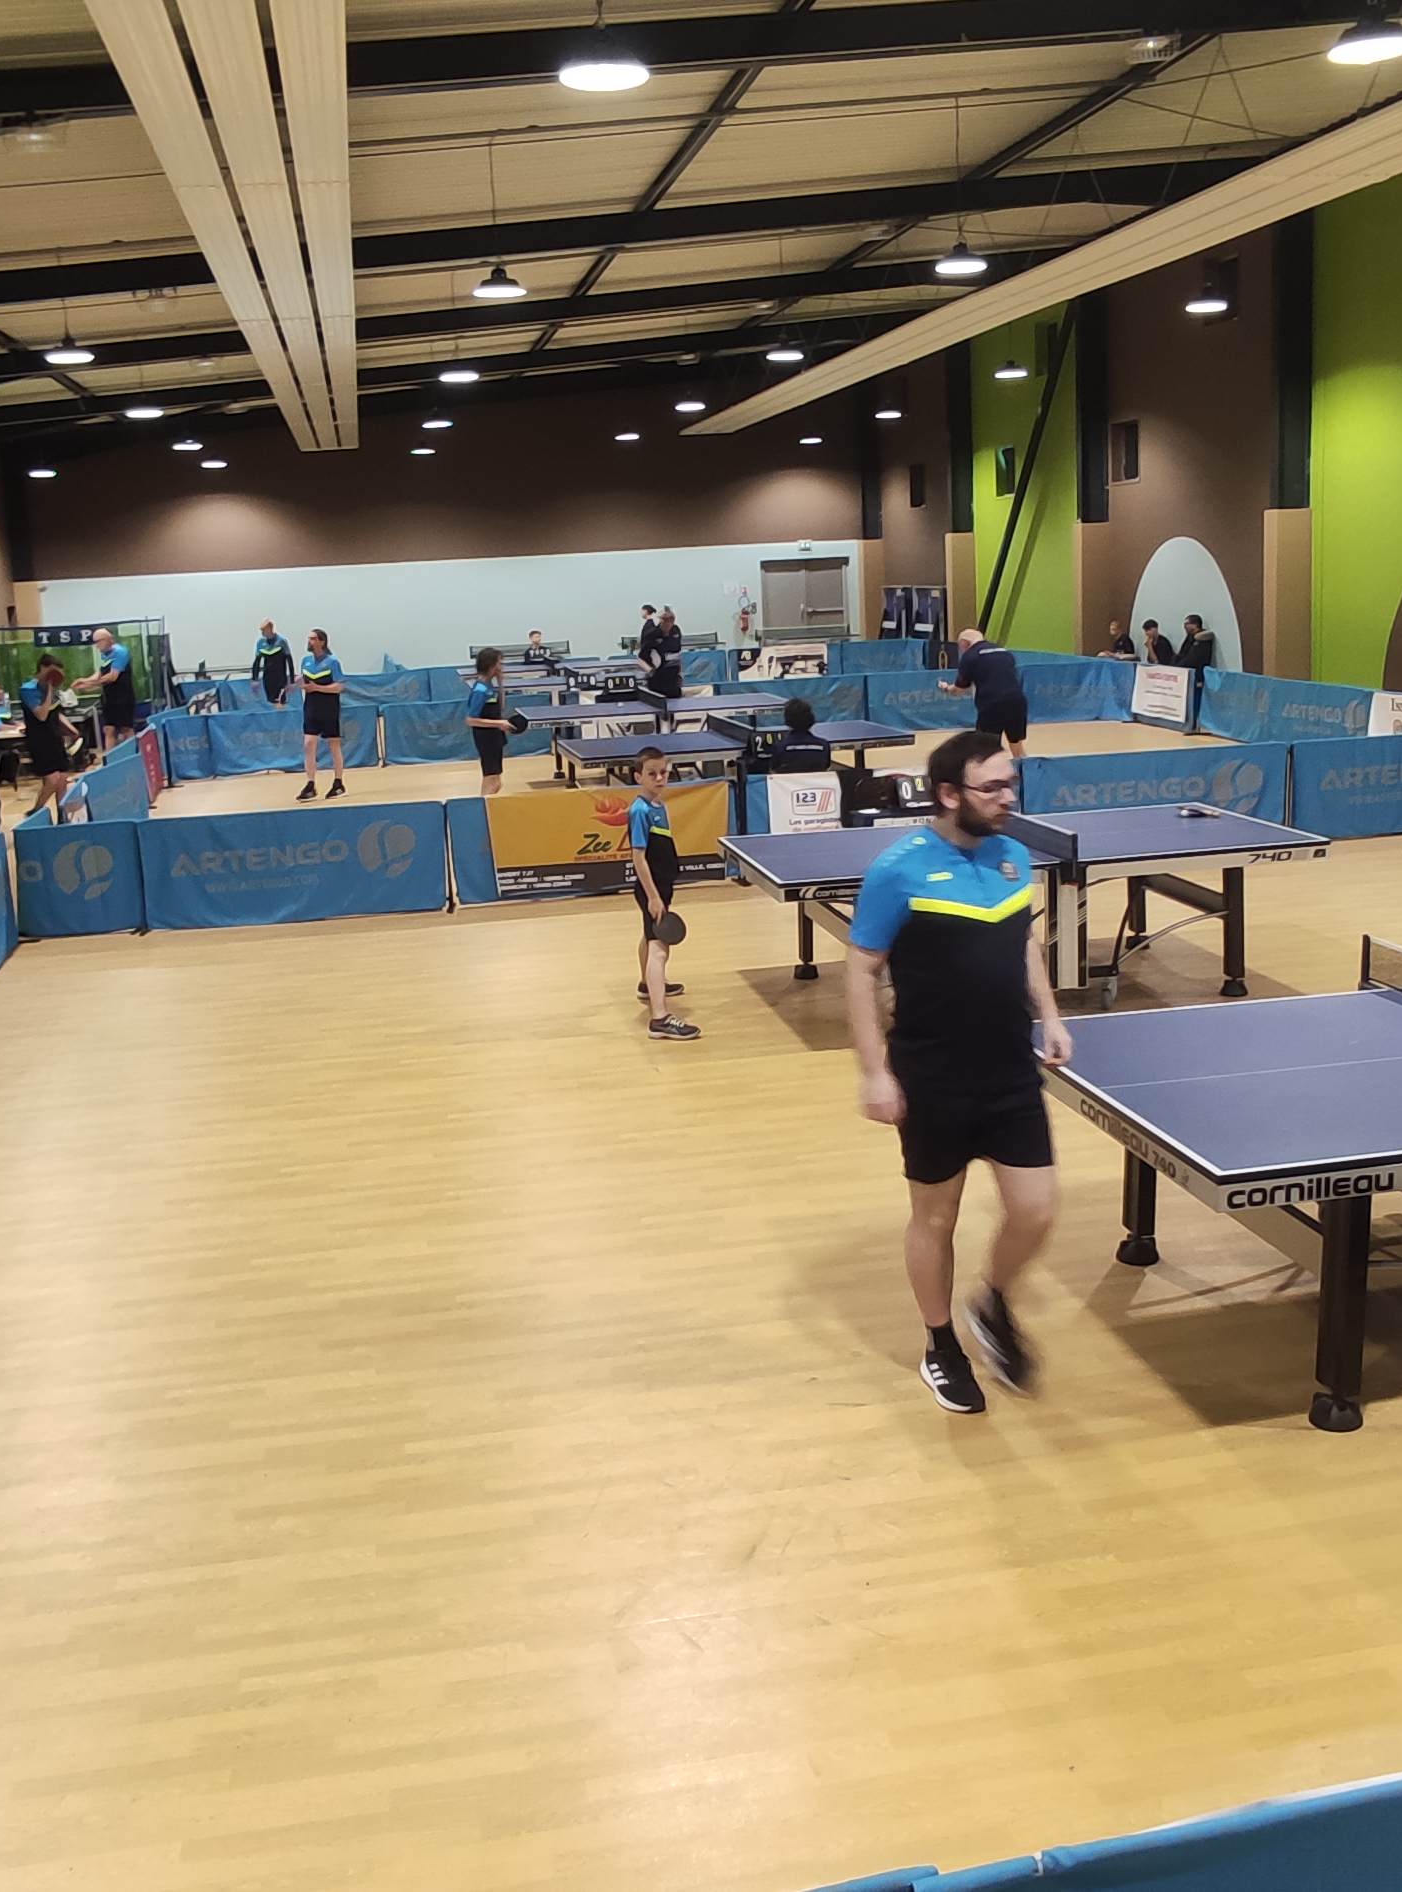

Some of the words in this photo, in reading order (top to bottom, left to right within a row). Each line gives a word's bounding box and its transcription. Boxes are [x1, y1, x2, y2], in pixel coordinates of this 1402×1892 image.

[796, 792, 817, 803] 123
[1053, 774, 1205, 808] ARTENGO
[170, 838, 349, 878] ARTENGO
[576, 832, 613, 855] Zee
[1248, 849, 1293, 864] 740
[1151, 1151, 1177, 1180] 740
[1226, 1171, 1396, 1211] cornilleau
